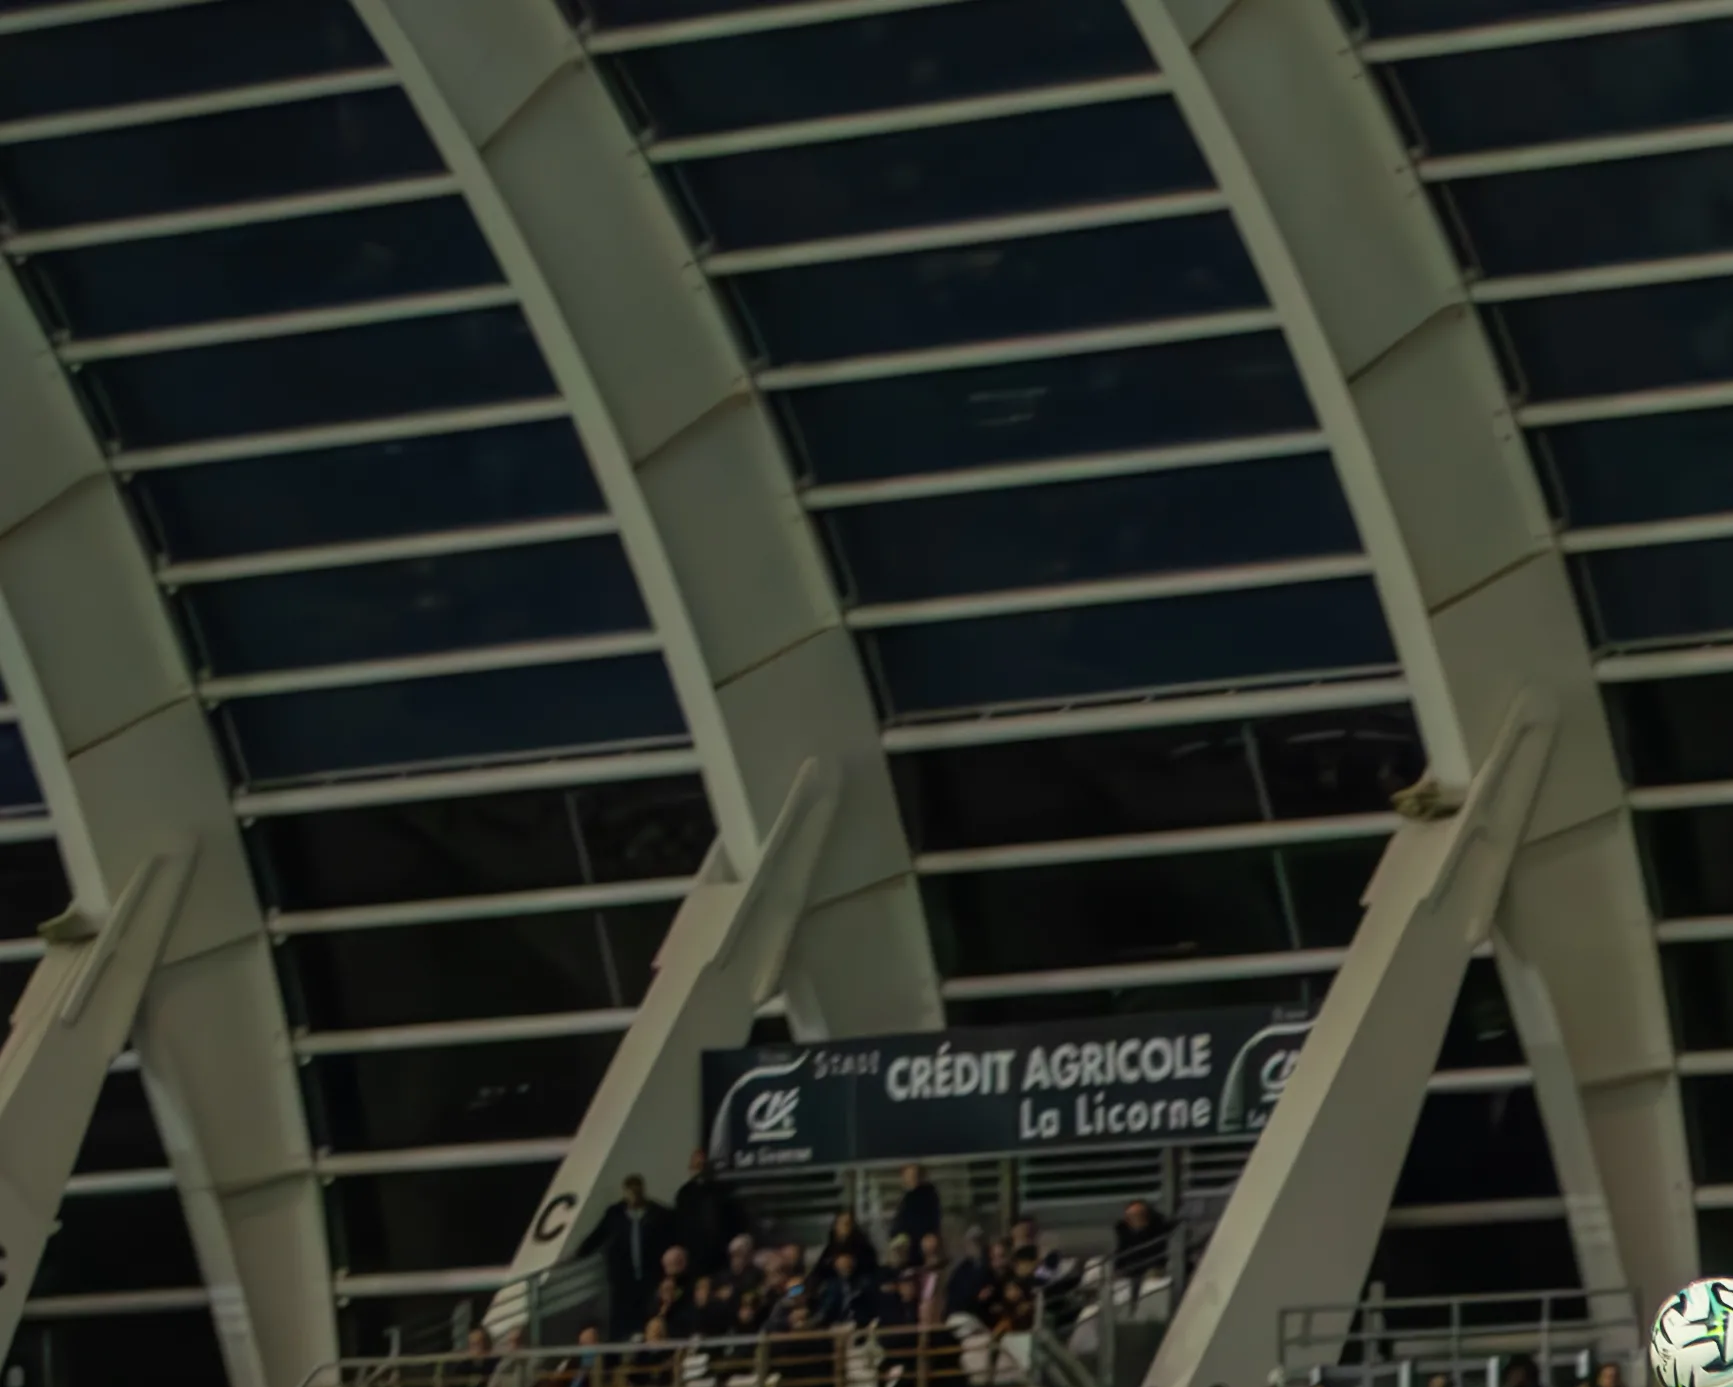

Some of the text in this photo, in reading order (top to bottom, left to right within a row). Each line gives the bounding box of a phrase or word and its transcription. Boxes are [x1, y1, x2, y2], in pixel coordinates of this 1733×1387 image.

[885, 1041, 1016, 1101] CRÉDIT
[1021, 1032, 1213, 1093] AGRICOLE
[1019, 1099, 1060, 1140] La
[1076, 1092, 1212, 1136] Licorne
[533, 1192, 577, 1243] C
